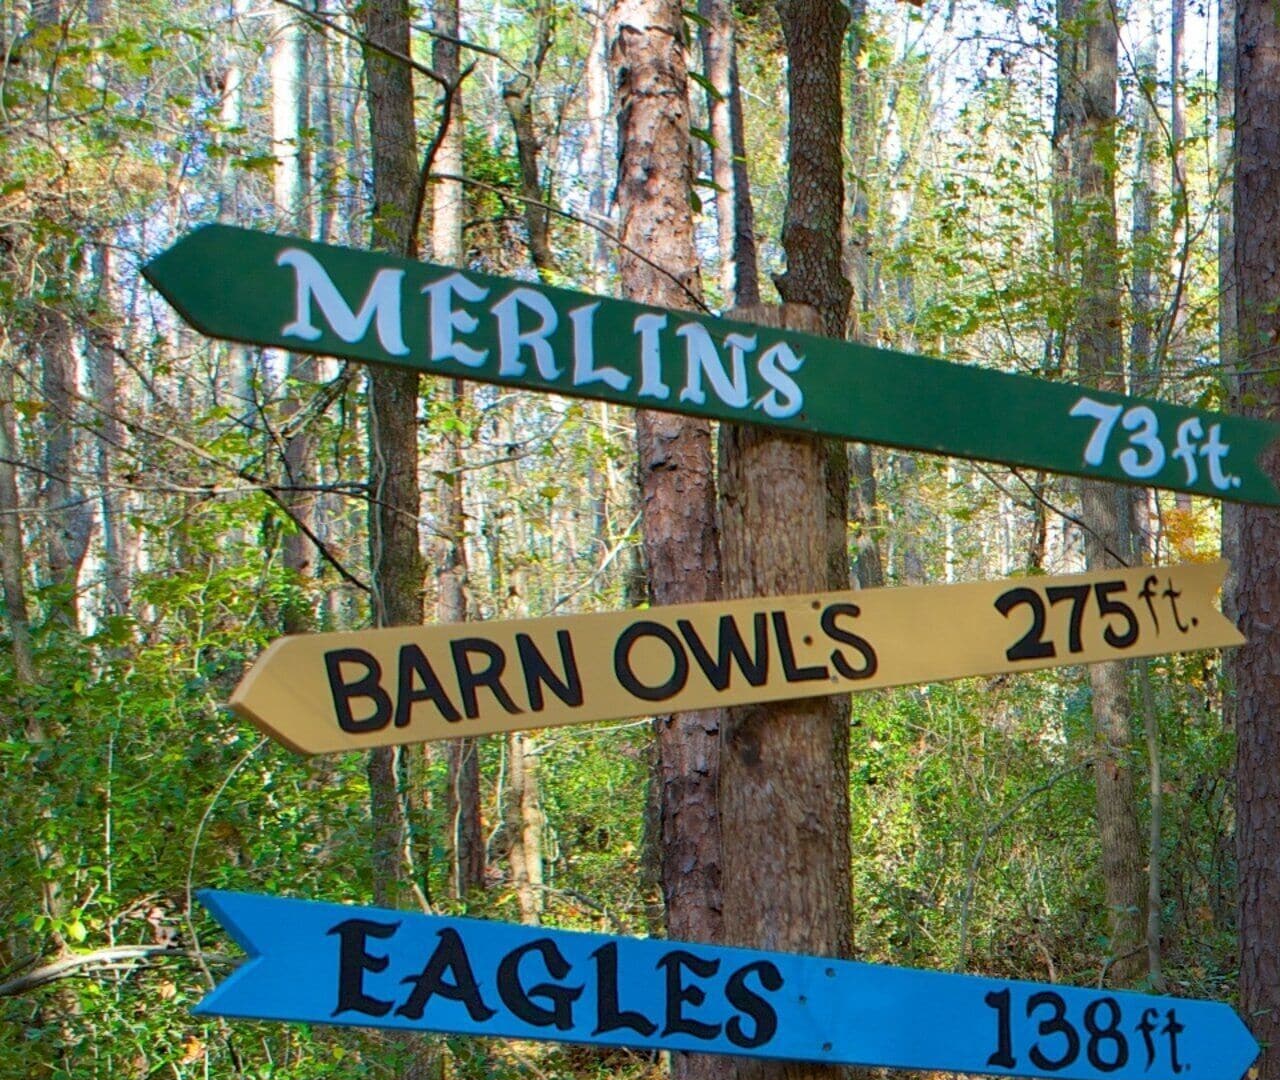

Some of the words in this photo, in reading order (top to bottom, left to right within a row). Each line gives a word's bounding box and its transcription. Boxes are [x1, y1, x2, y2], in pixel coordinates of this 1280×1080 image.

[277, 248, 805, 418] MERLINS
[323, 630, 584, 733] BARN
[326, 918, 784, 1049] EAGLES
